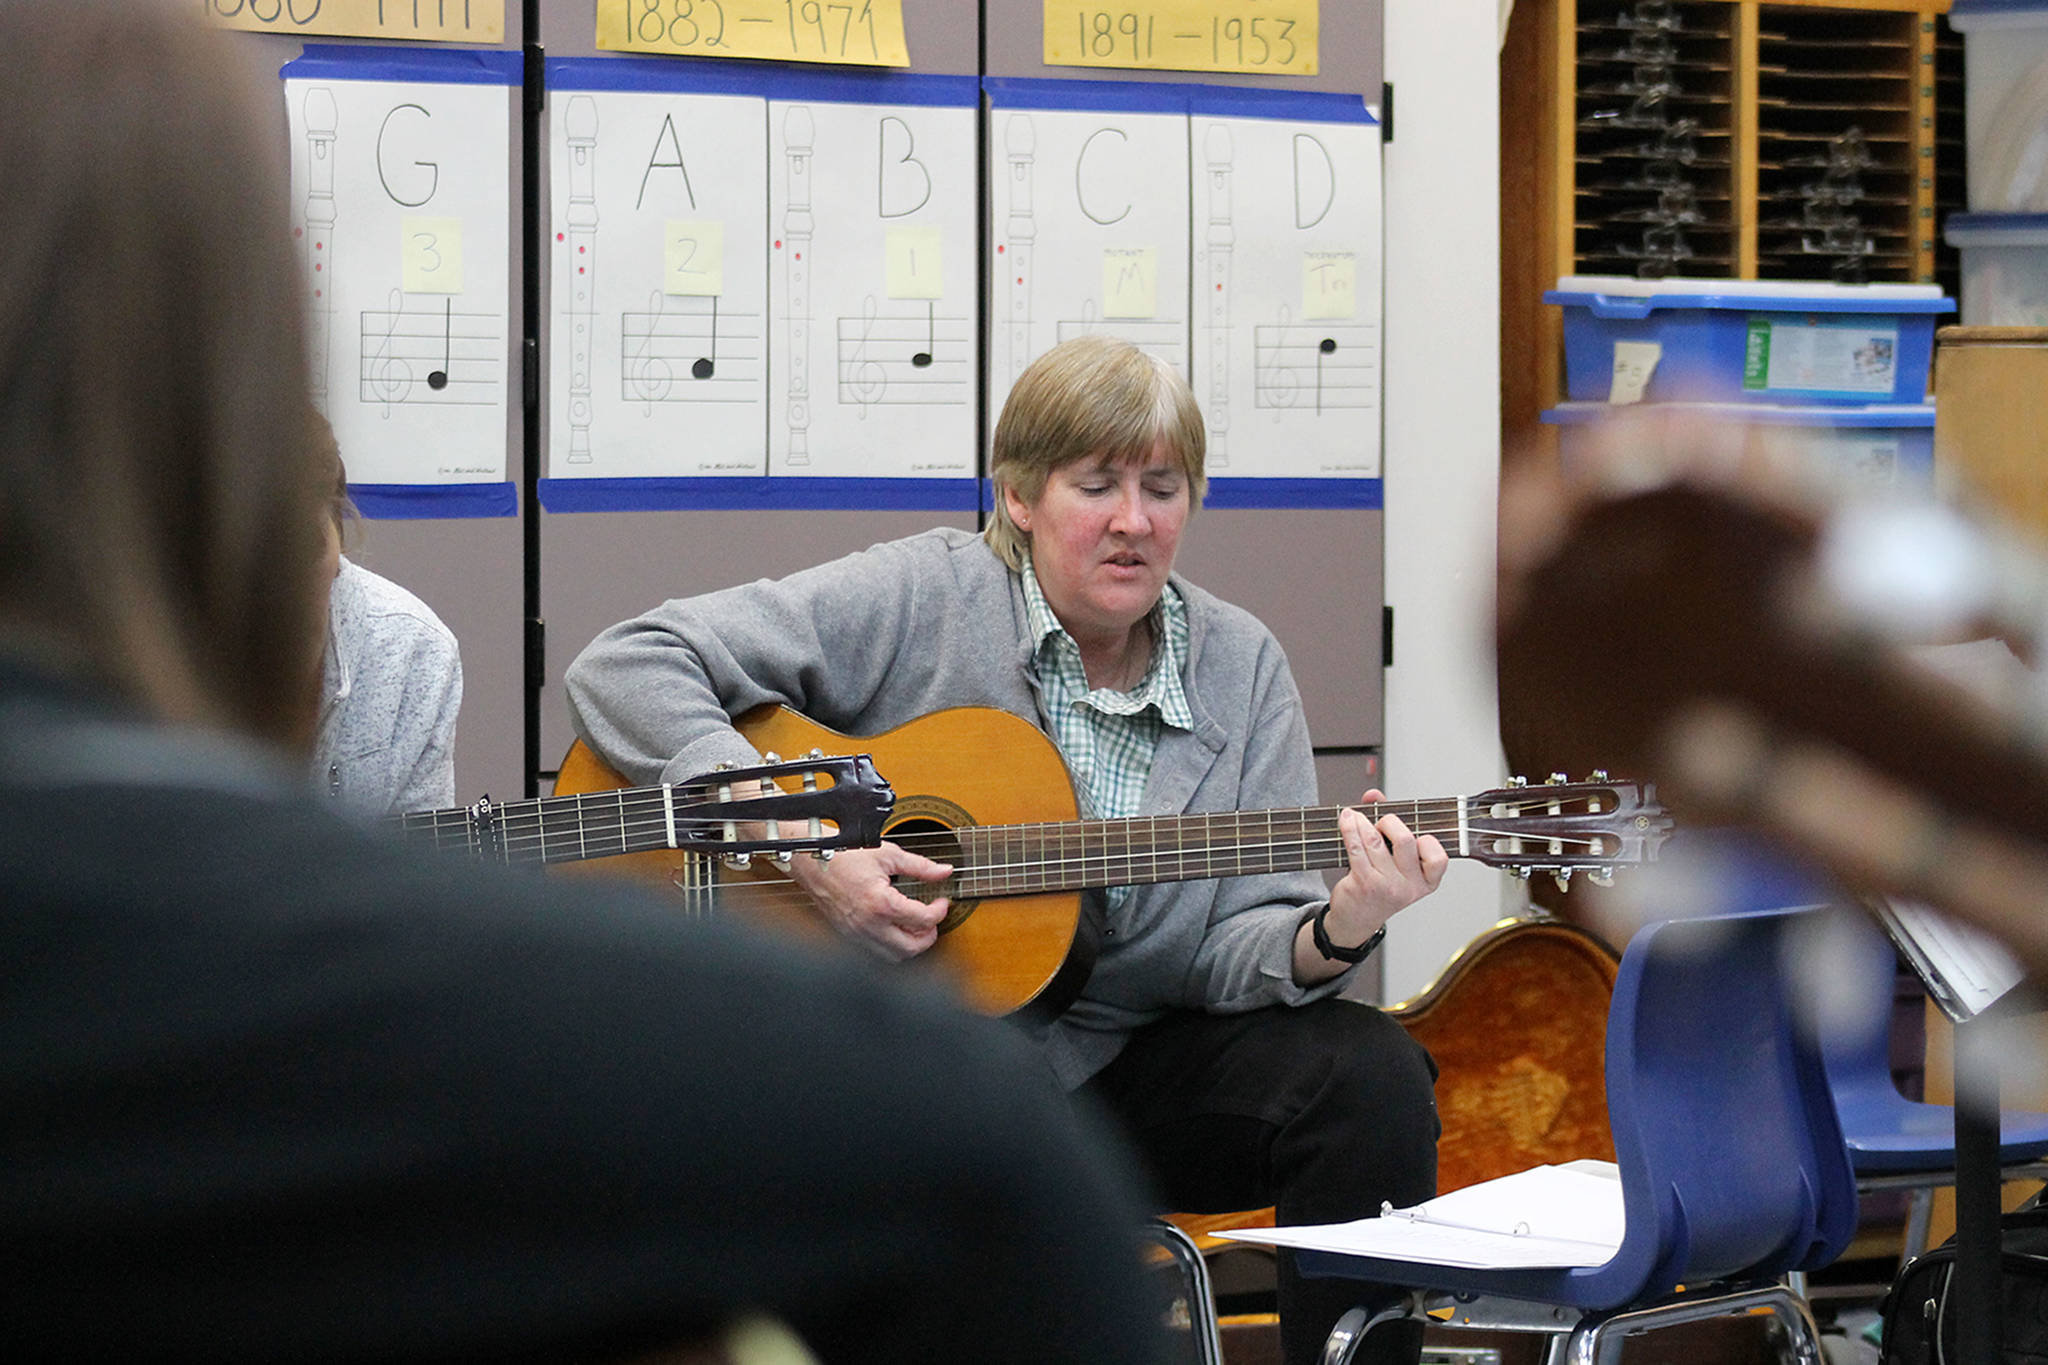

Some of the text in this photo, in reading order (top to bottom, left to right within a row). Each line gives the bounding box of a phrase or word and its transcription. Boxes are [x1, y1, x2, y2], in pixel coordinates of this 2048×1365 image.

[627, 0, 730, 48] 1882
[1079, 12, 1155, 61] 1891
[1213, 17, 1298, 65] 1953
[376, 103, 439, 208] G
[635, 112, 697, 211] A
[878, 116, 932, 219] B
[1076, 127, 1132, 225] C
[1293, 132, 1336, 230] D
[413, 232, 442, 273] 3
[676, 237, 707, 274] 2
